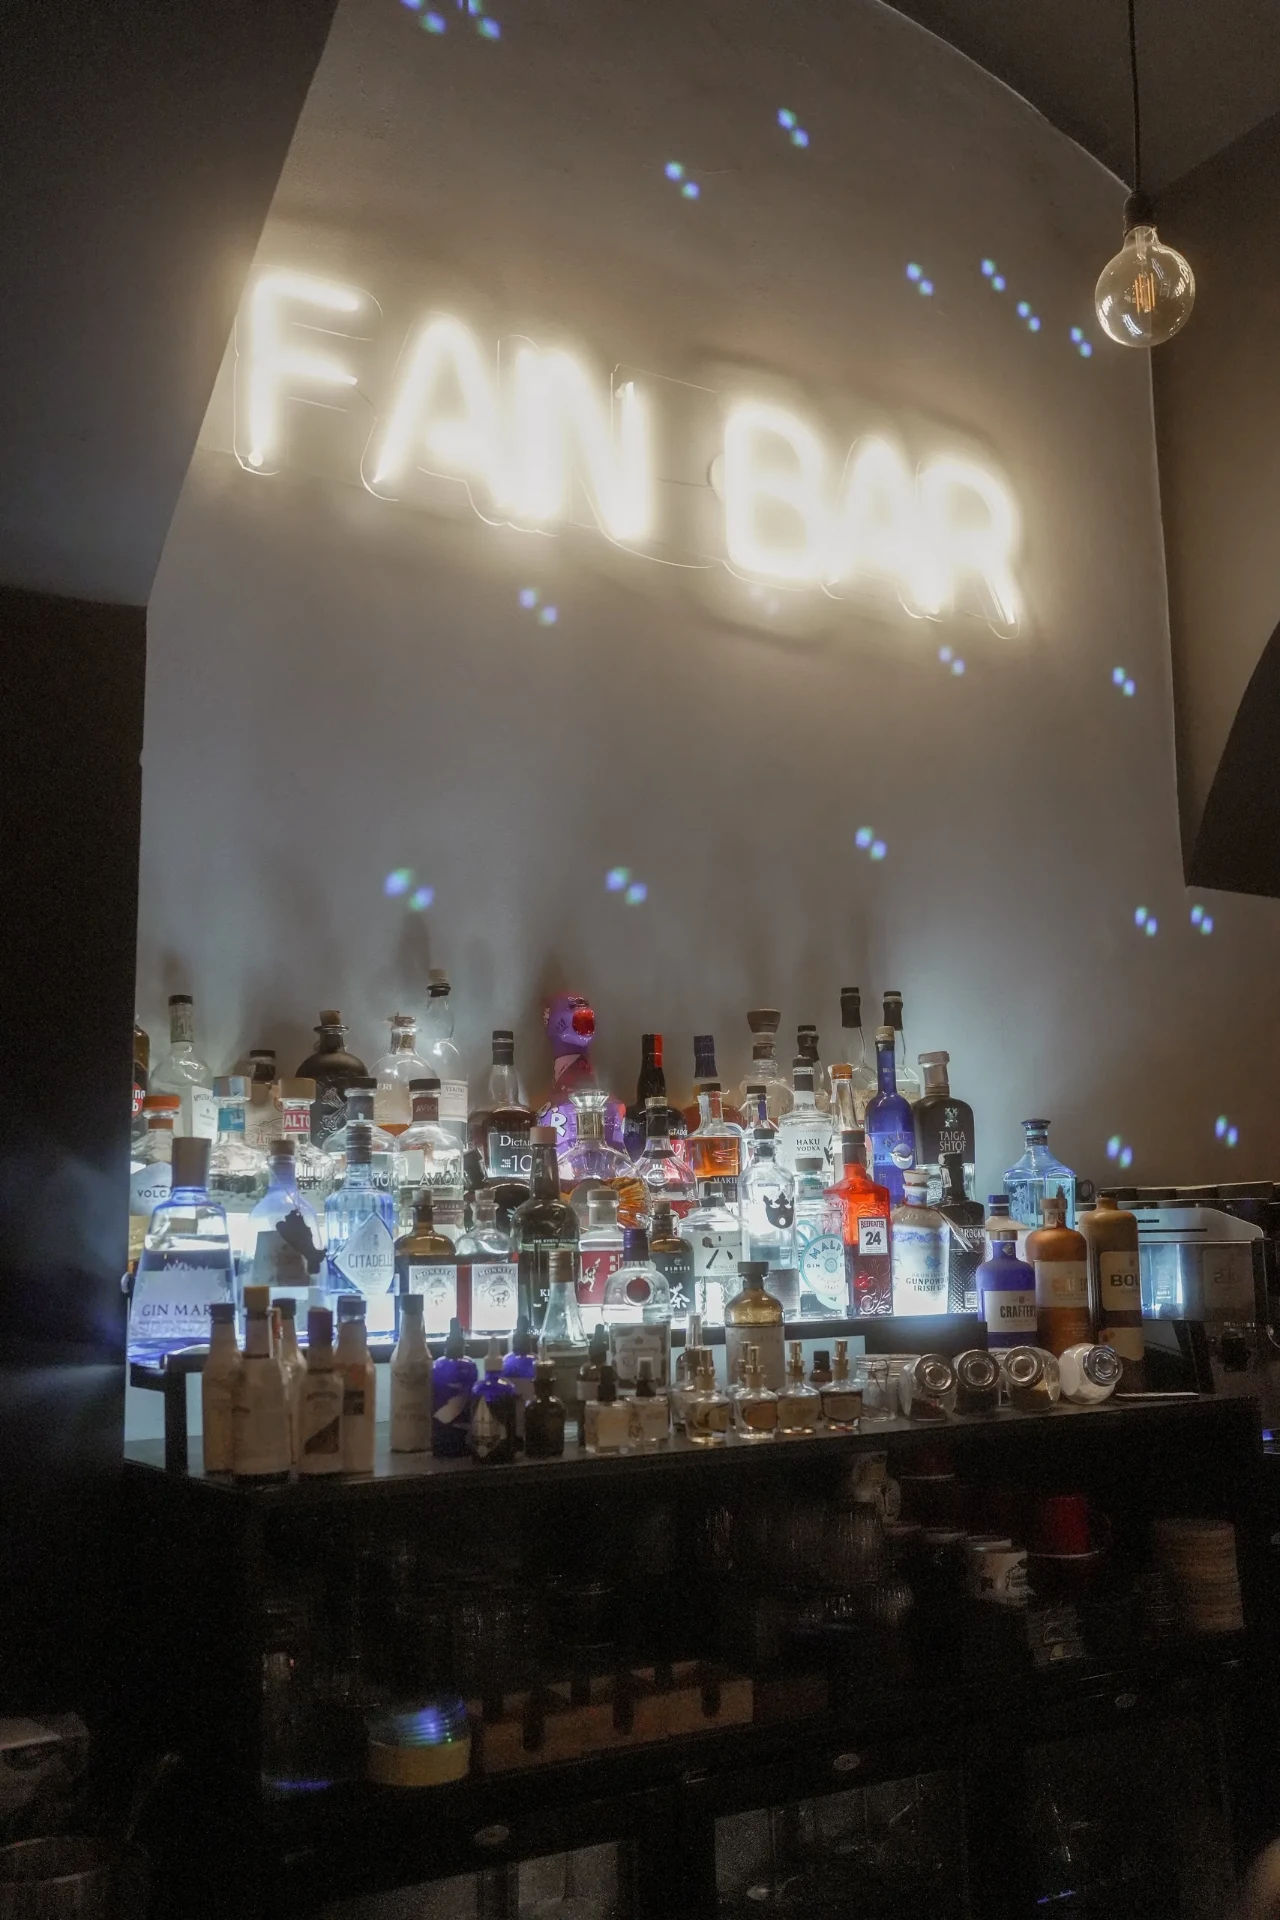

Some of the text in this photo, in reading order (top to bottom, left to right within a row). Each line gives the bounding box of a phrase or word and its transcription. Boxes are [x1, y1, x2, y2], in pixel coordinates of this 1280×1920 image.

[247, 274, 1022, 626] FAN BAR
[939, 1131, 966, 1140] TAIGA
[939, 1141, 967, 1151] SHTOF
[860, 1220, 885, 1230] BEEFEATER
[960, 1228, 985, 1238] ROCK
[865, 1232, 882, 1246] 24
[141, 1304, 169, 1316] GIN
